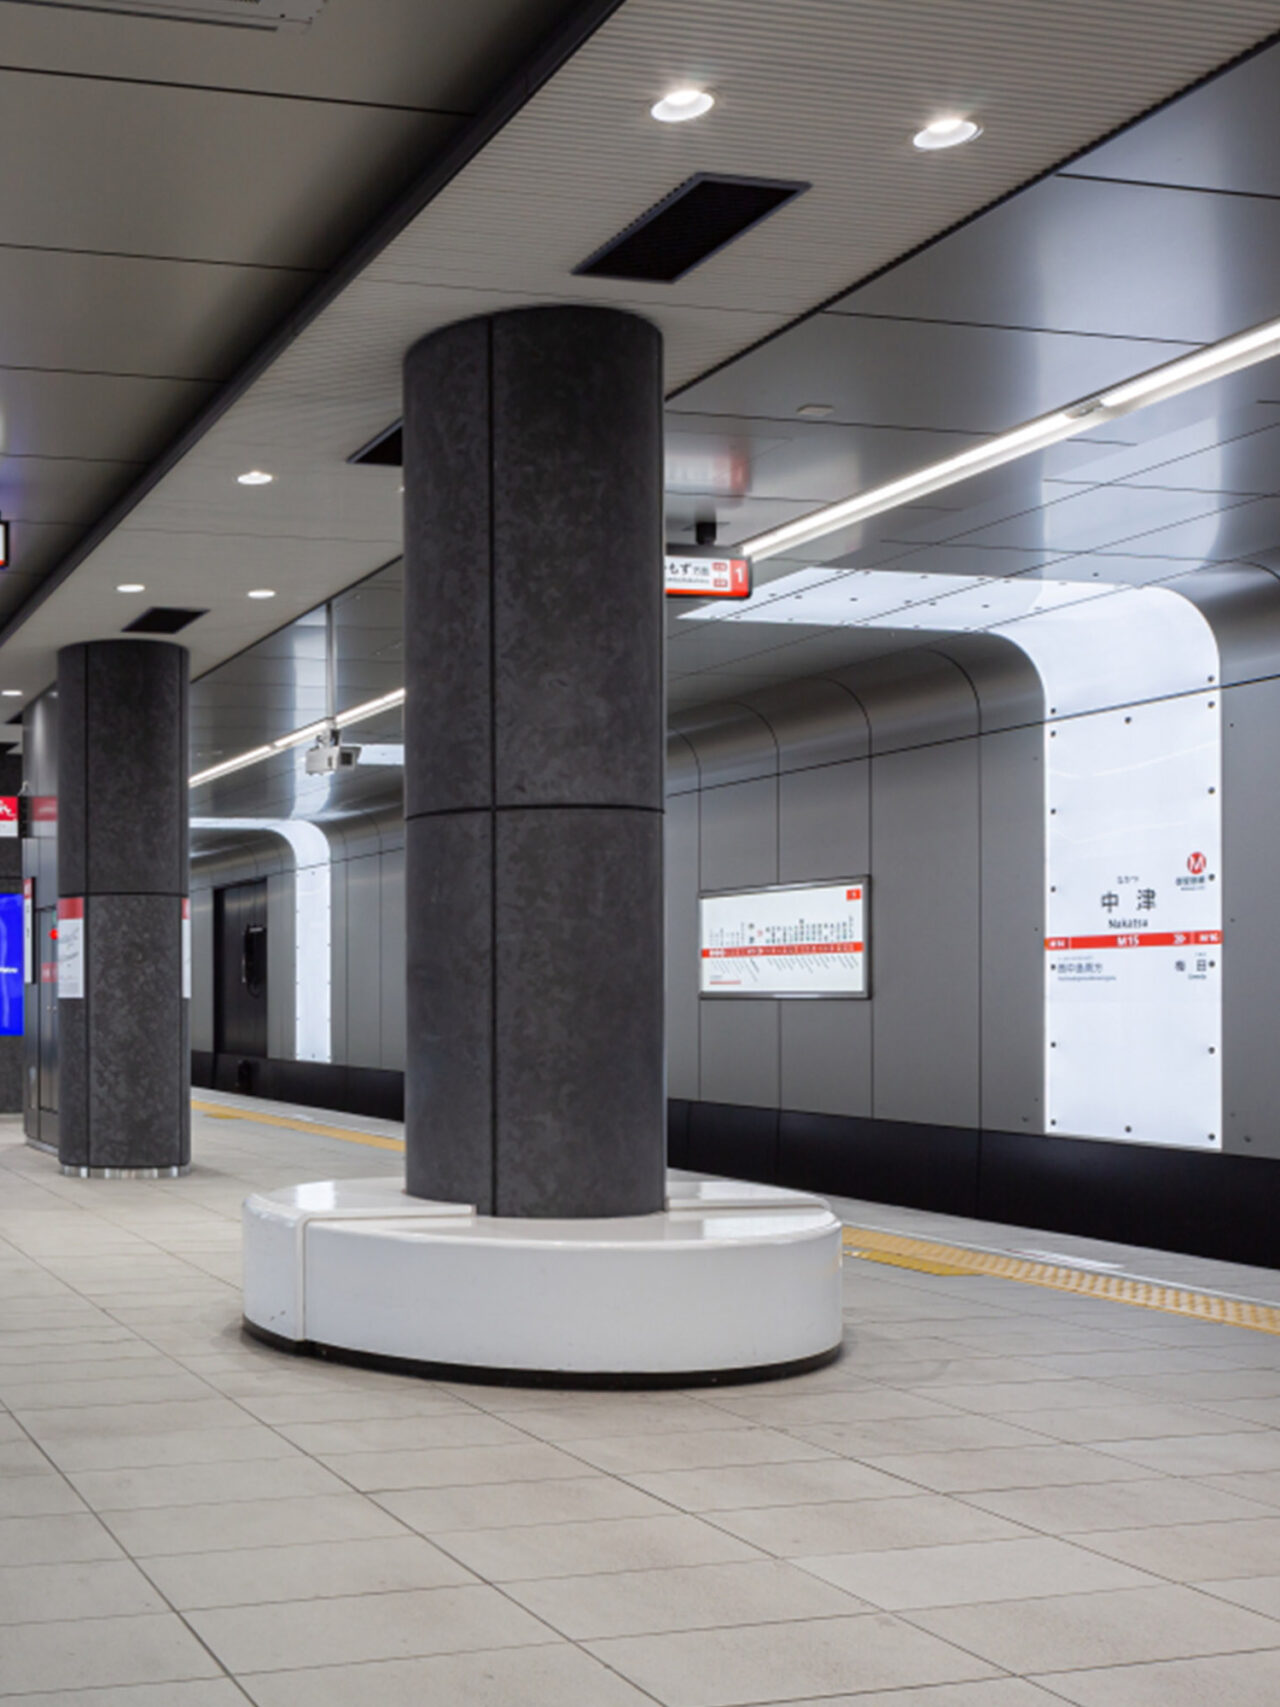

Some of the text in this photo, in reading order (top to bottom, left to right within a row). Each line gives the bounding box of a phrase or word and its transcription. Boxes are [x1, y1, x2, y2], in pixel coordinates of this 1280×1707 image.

[734, 566, 745, 583] 1
[1101, 888, 1157, 913] 中津
[1108, 918, 1149, 929] Nakatsu
[1116, 935, 1140, 948] M15
